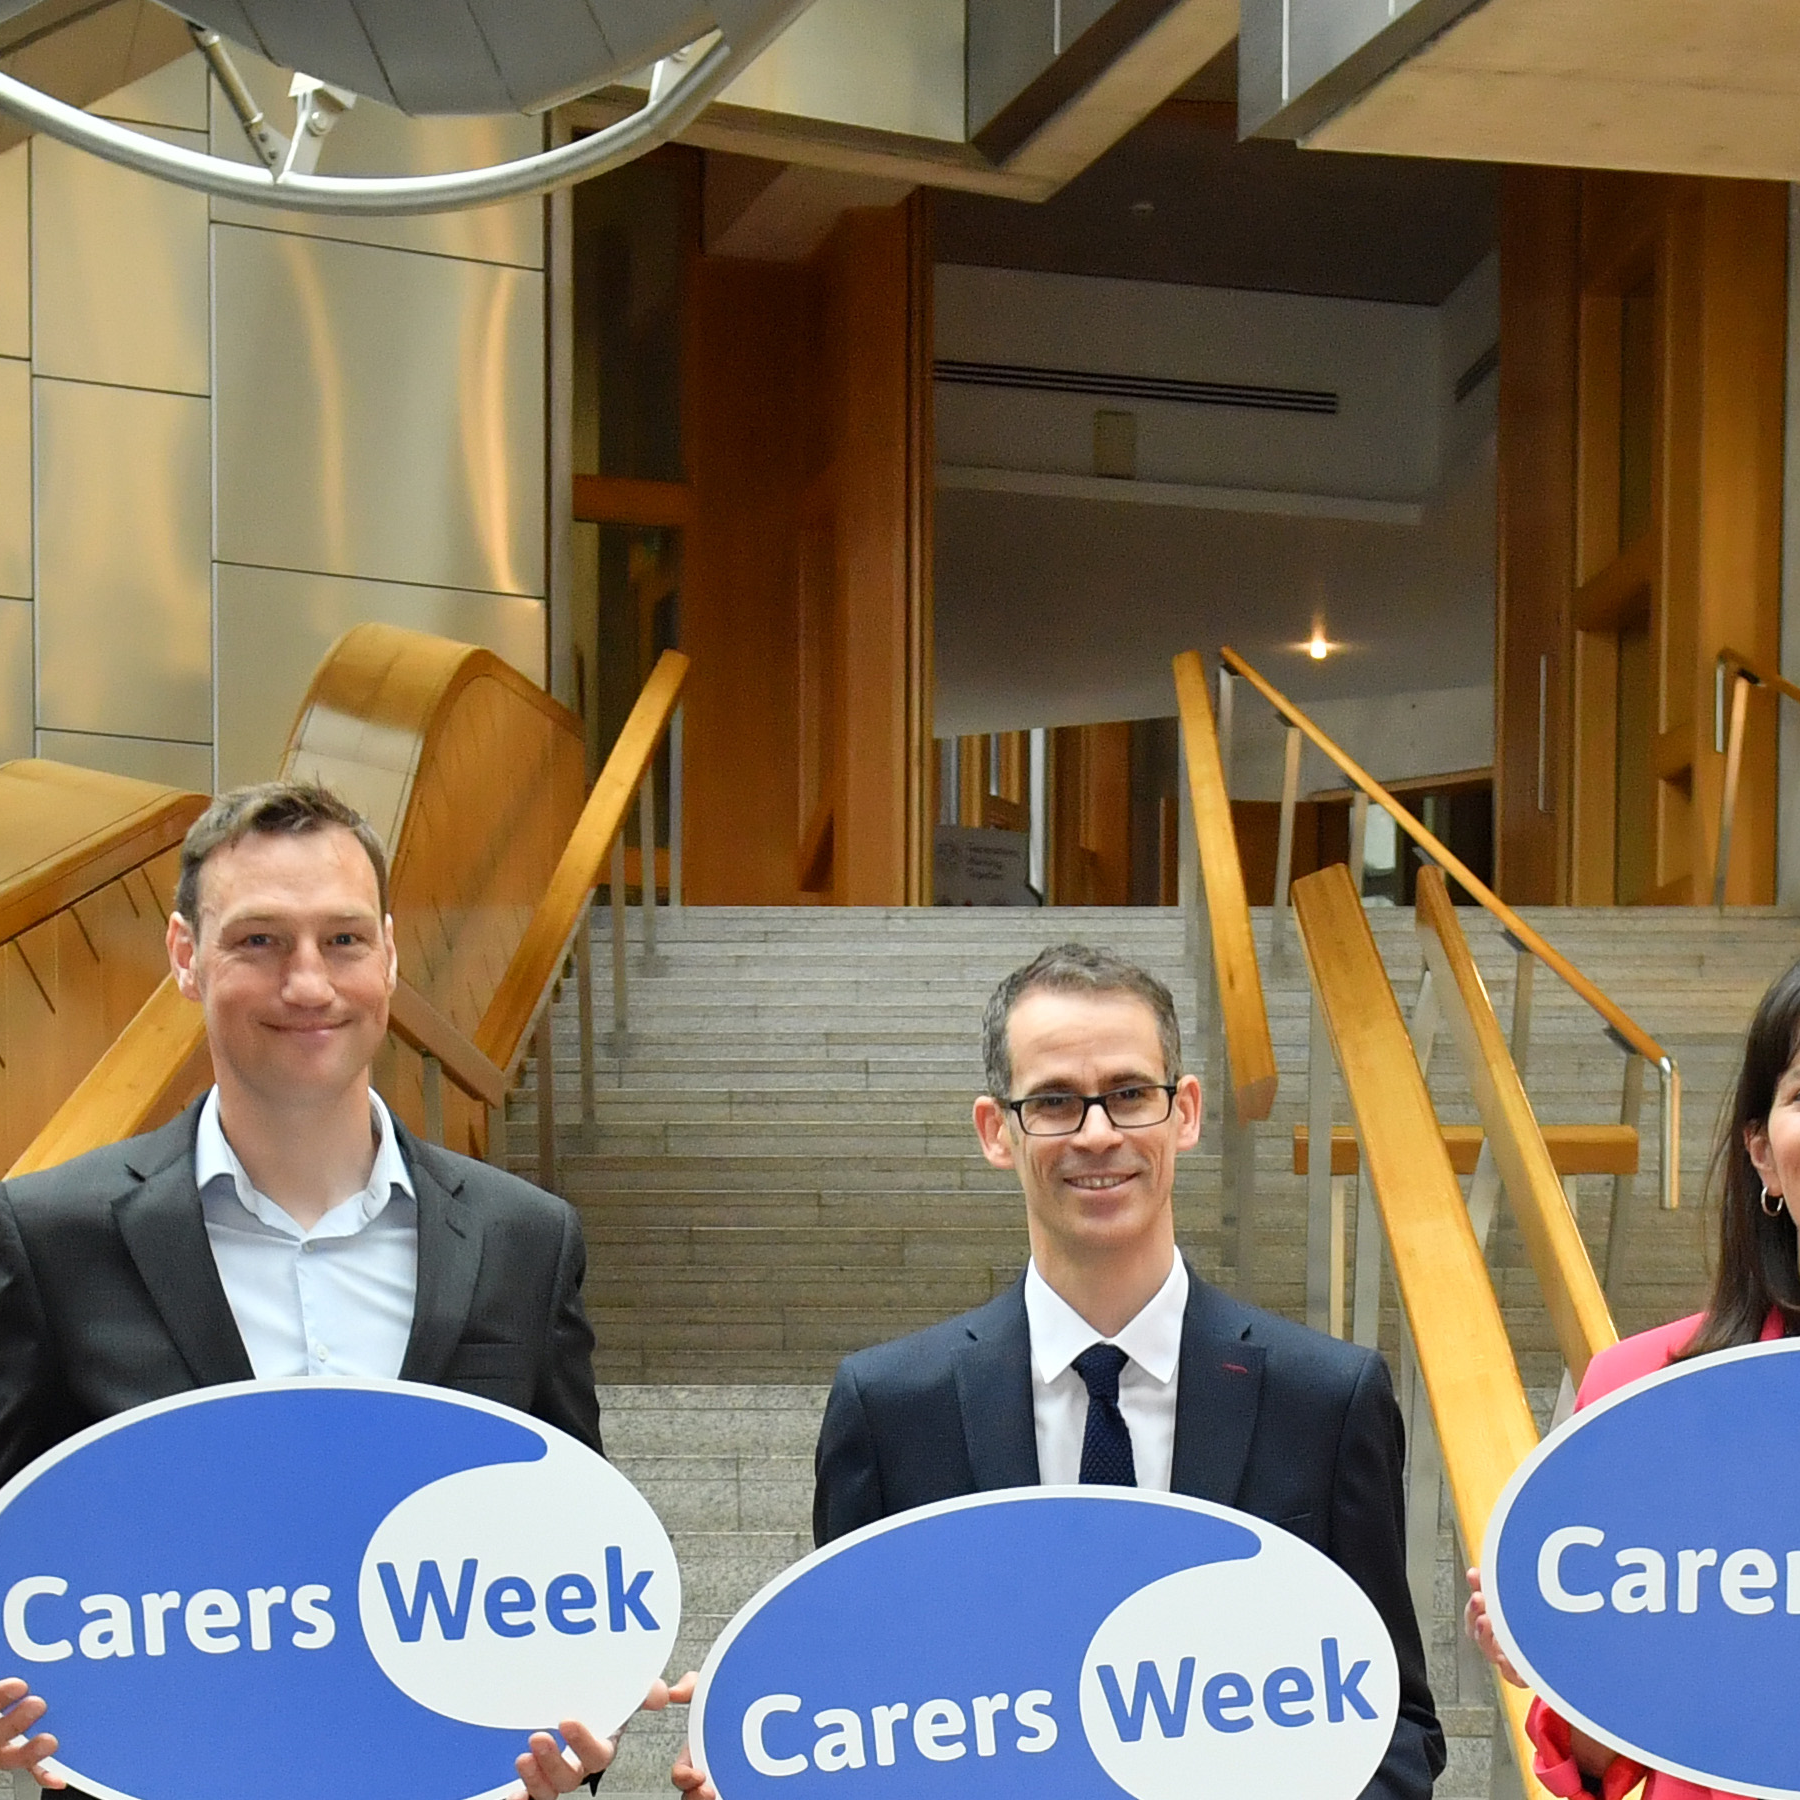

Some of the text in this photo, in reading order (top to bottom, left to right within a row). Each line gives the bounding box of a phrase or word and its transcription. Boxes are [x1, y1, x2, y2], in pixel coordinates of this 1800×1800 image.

[2, 1546, 660, 1663] Carers Week
[741, 1637, 1379, 1777] Carers Week
